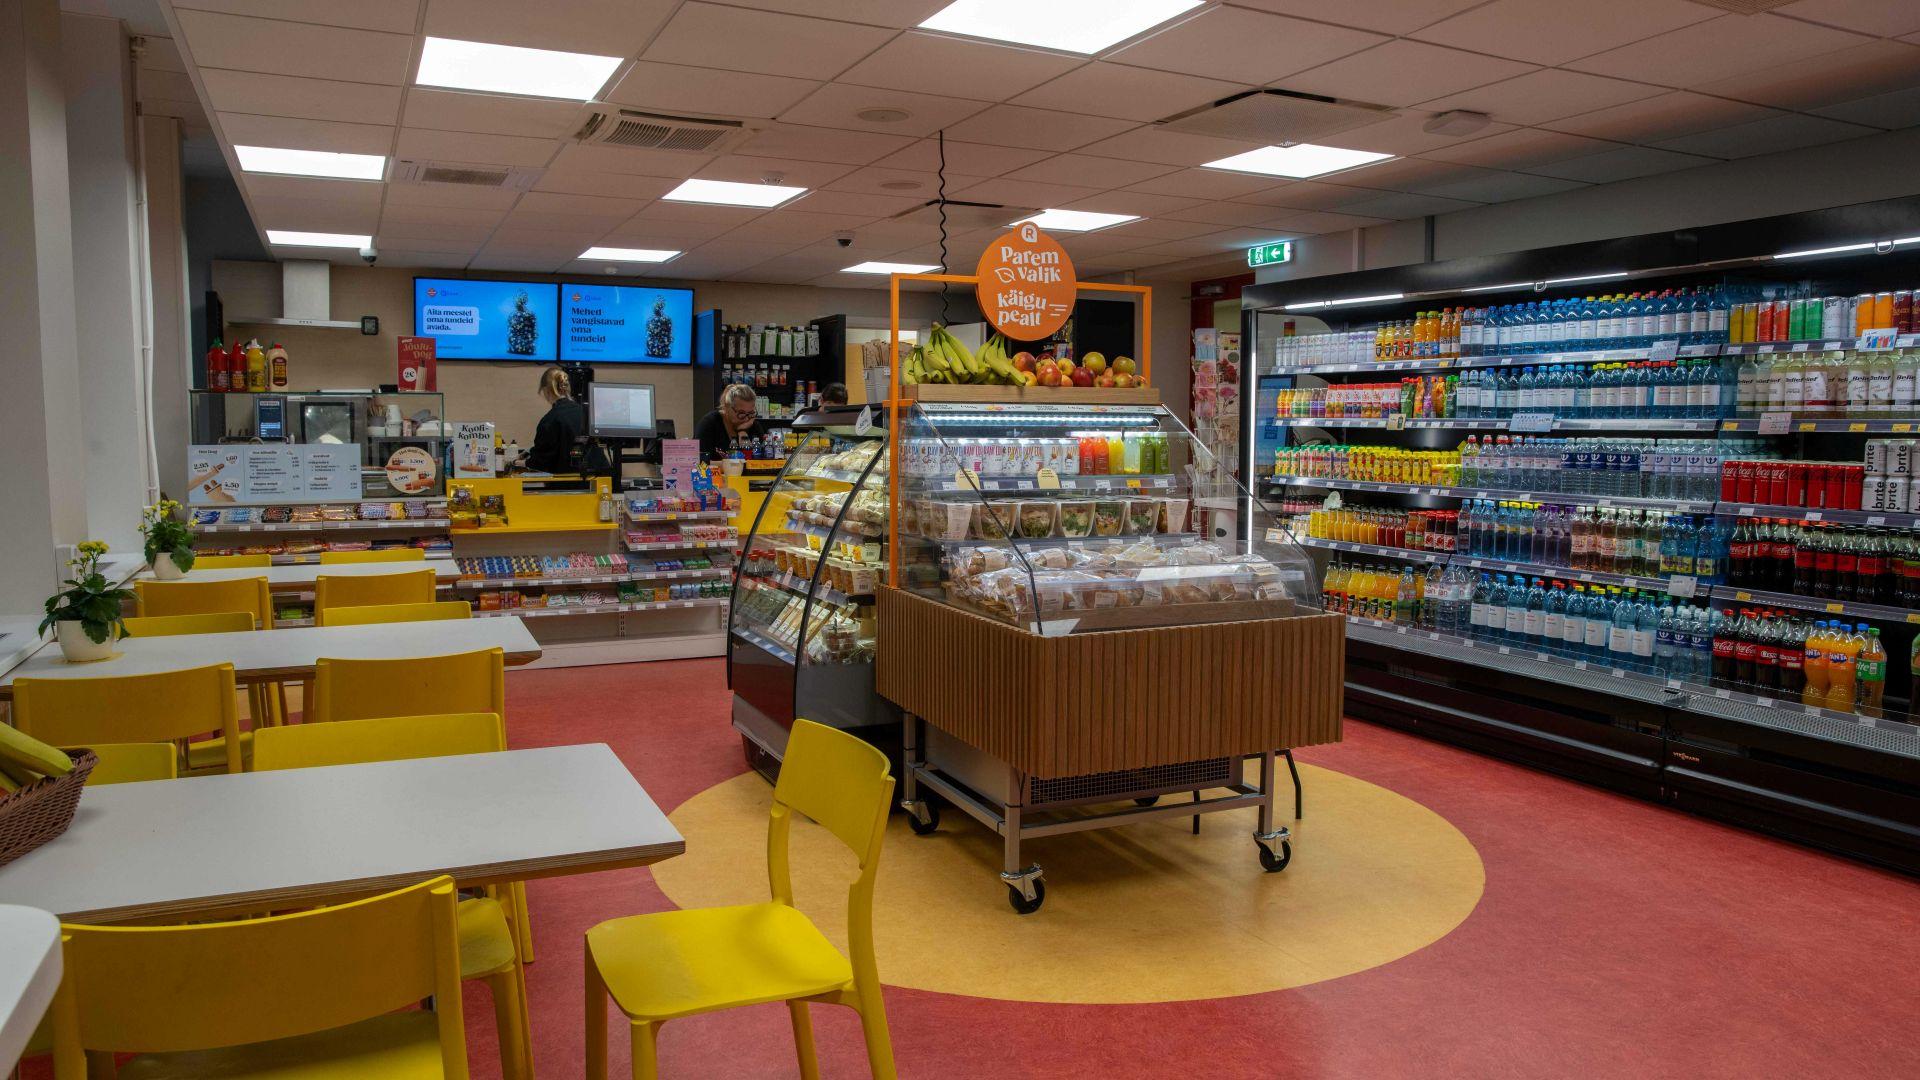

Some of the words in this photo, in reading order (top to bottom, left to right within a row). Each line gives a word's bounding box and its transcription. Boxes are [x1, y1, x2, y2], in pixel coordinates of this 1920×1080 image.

[1001, 246, 1059, 266] Parem
[1018, 266, 1061, 283] Valik
[998, 289, 1047, 310] käigu
[426, 308, 442, 316] Aita
[443, 309, 472, 317] meestel
[571, 306, 602, 316] Mehed
[997, 309, 1041, 326] pealt
[571, 317, 625, 326] vangistavad
[571, 334, 606, 344] tundeid
[458, 432, 490, 440] kombo
[1865, 444, 1878, 473] brite
[1894, 445, 1910, 474] brite
[1872, 481, 1885, 509] brite
[1886, 482, 1901, 510] brite
